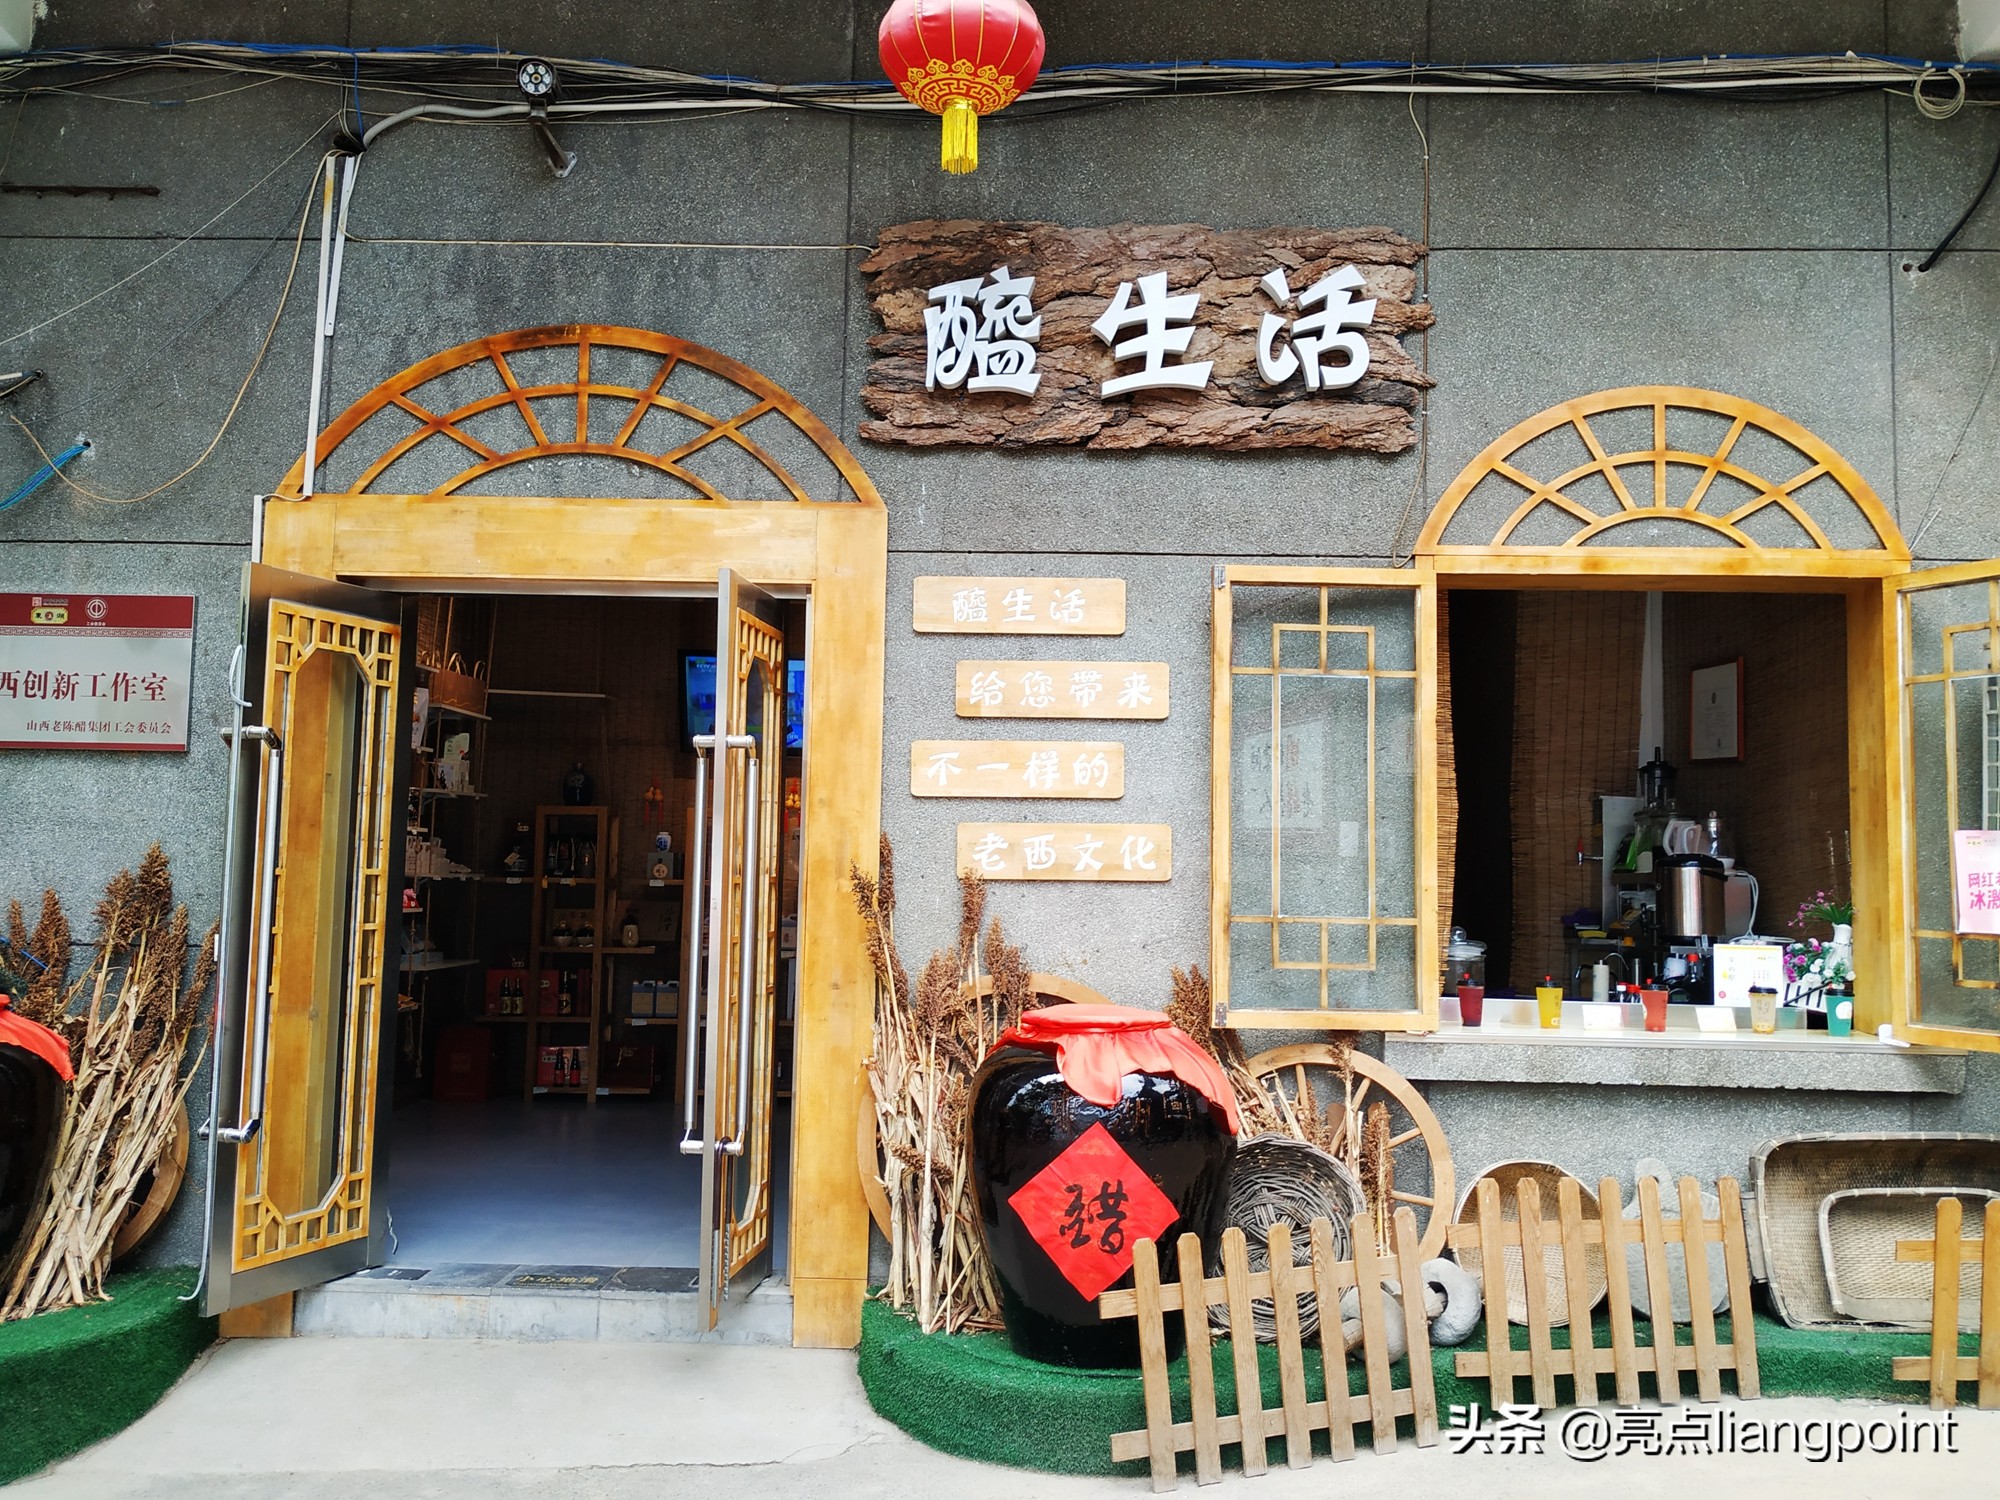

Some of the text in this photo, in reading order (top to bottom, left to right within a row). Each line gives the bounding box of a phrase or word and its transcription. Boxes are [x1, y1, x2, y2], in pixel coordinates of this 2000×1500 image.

[0, 670, 168, 702] 西创新工作室
[26, 719, 172, 735] 山西老陈醋集团工会委员会
[926, 750, 1109, 789] 不一样的
[971, 832, 1157, 871] 老西文化
[1058, 1179, 1129, 1255] 醋
